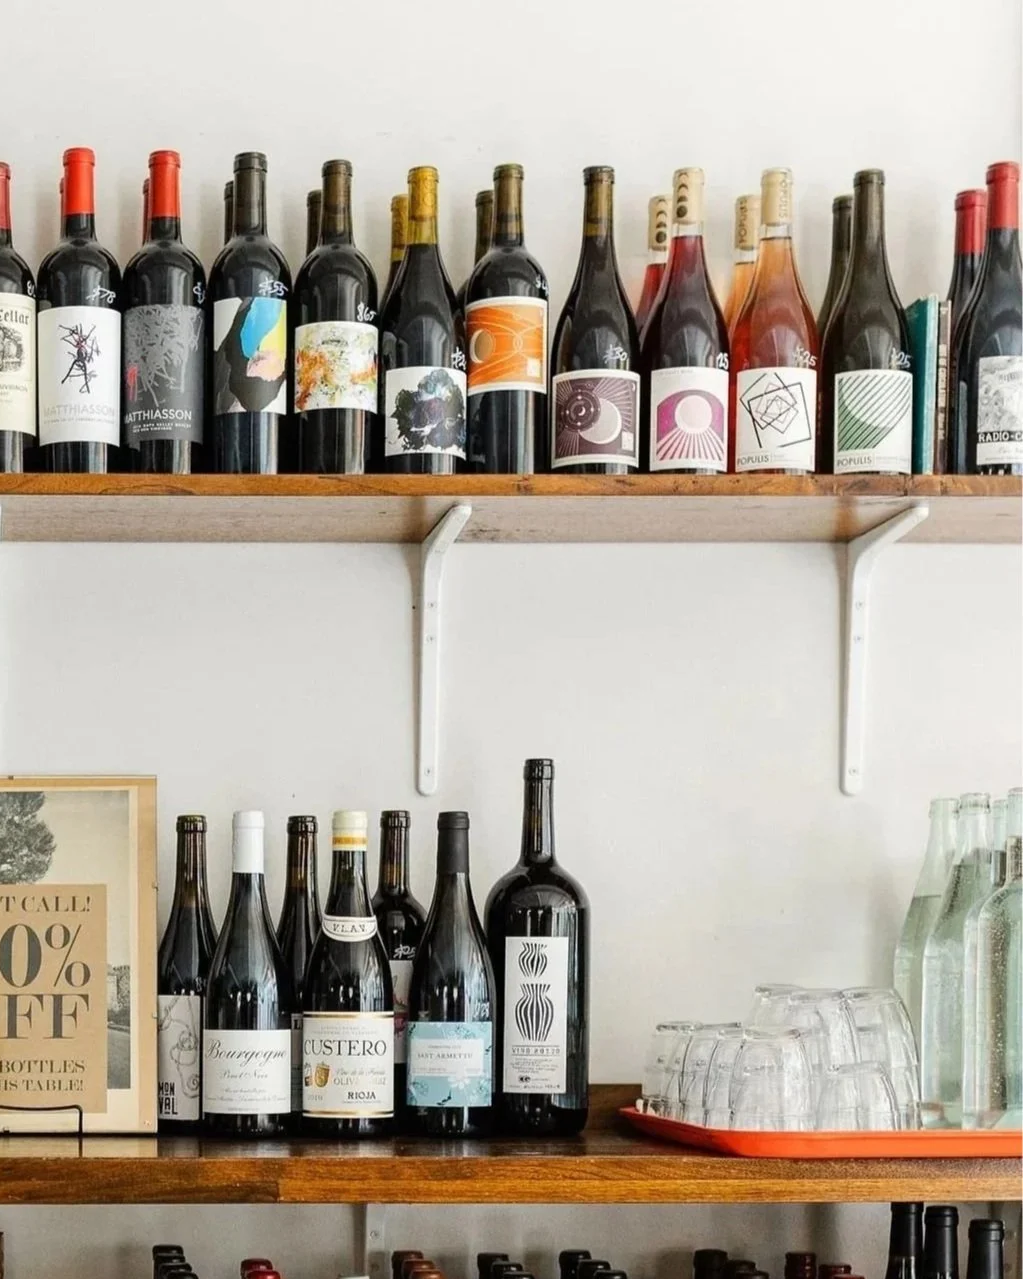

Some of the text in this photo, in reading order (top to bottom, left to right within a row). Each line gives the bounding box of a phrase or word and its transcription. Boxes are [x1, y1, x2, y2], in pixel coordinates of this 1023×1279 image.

[836, 456, 872, 466] POPULIS
[21, 895, 91, 912] CALL!
[206, 1039, 287, 1067] Bourgogne
[0, 1060, 85, 1074] BOTTLES
[23, 1079, 84, 1092] TABLE!
[348, 1091, 377, 1100] RIOJA
